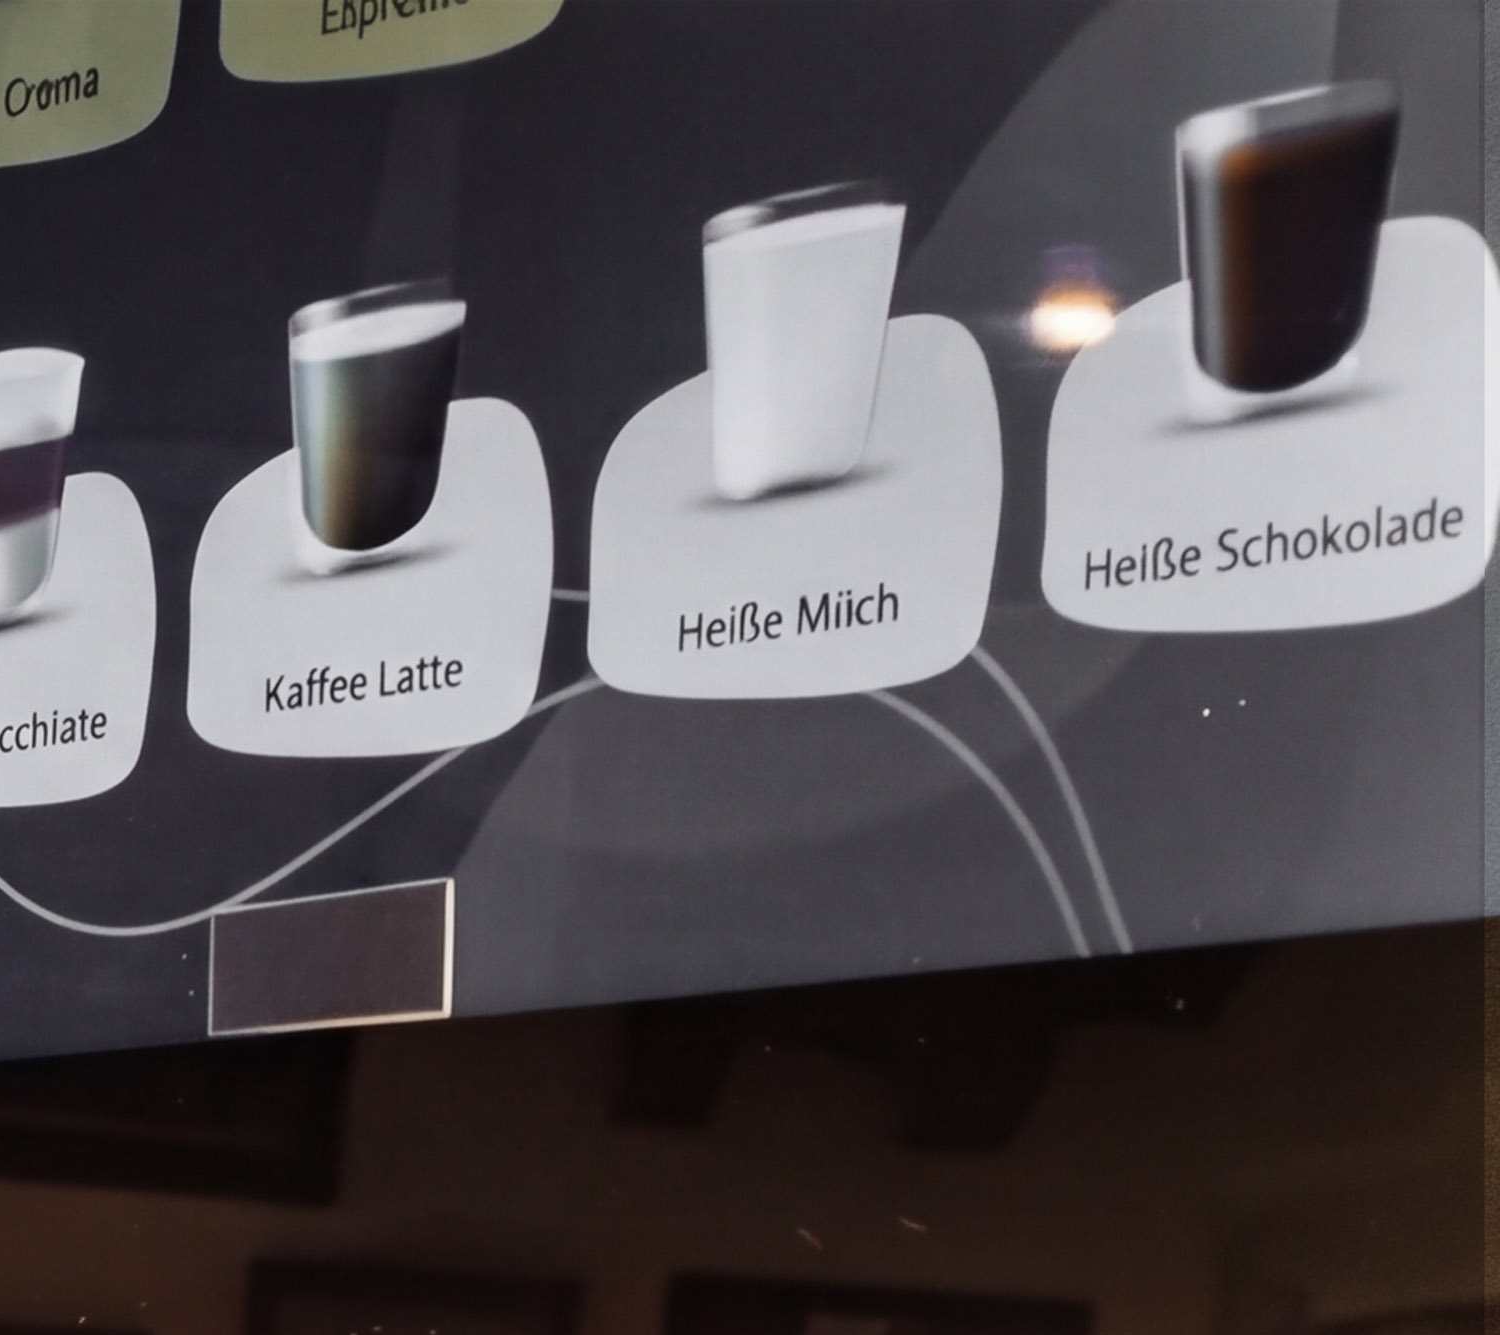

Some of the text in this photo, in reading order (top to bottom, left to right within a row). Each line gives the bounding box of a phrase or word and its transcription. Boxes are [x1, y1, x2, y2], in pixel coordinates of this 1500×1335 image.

[1085, 496, 1464, 590] Heiße Schokolade
[678, 601, 783, 652] Heiße
[265, 656, 464, 712] Kaffee Latte
